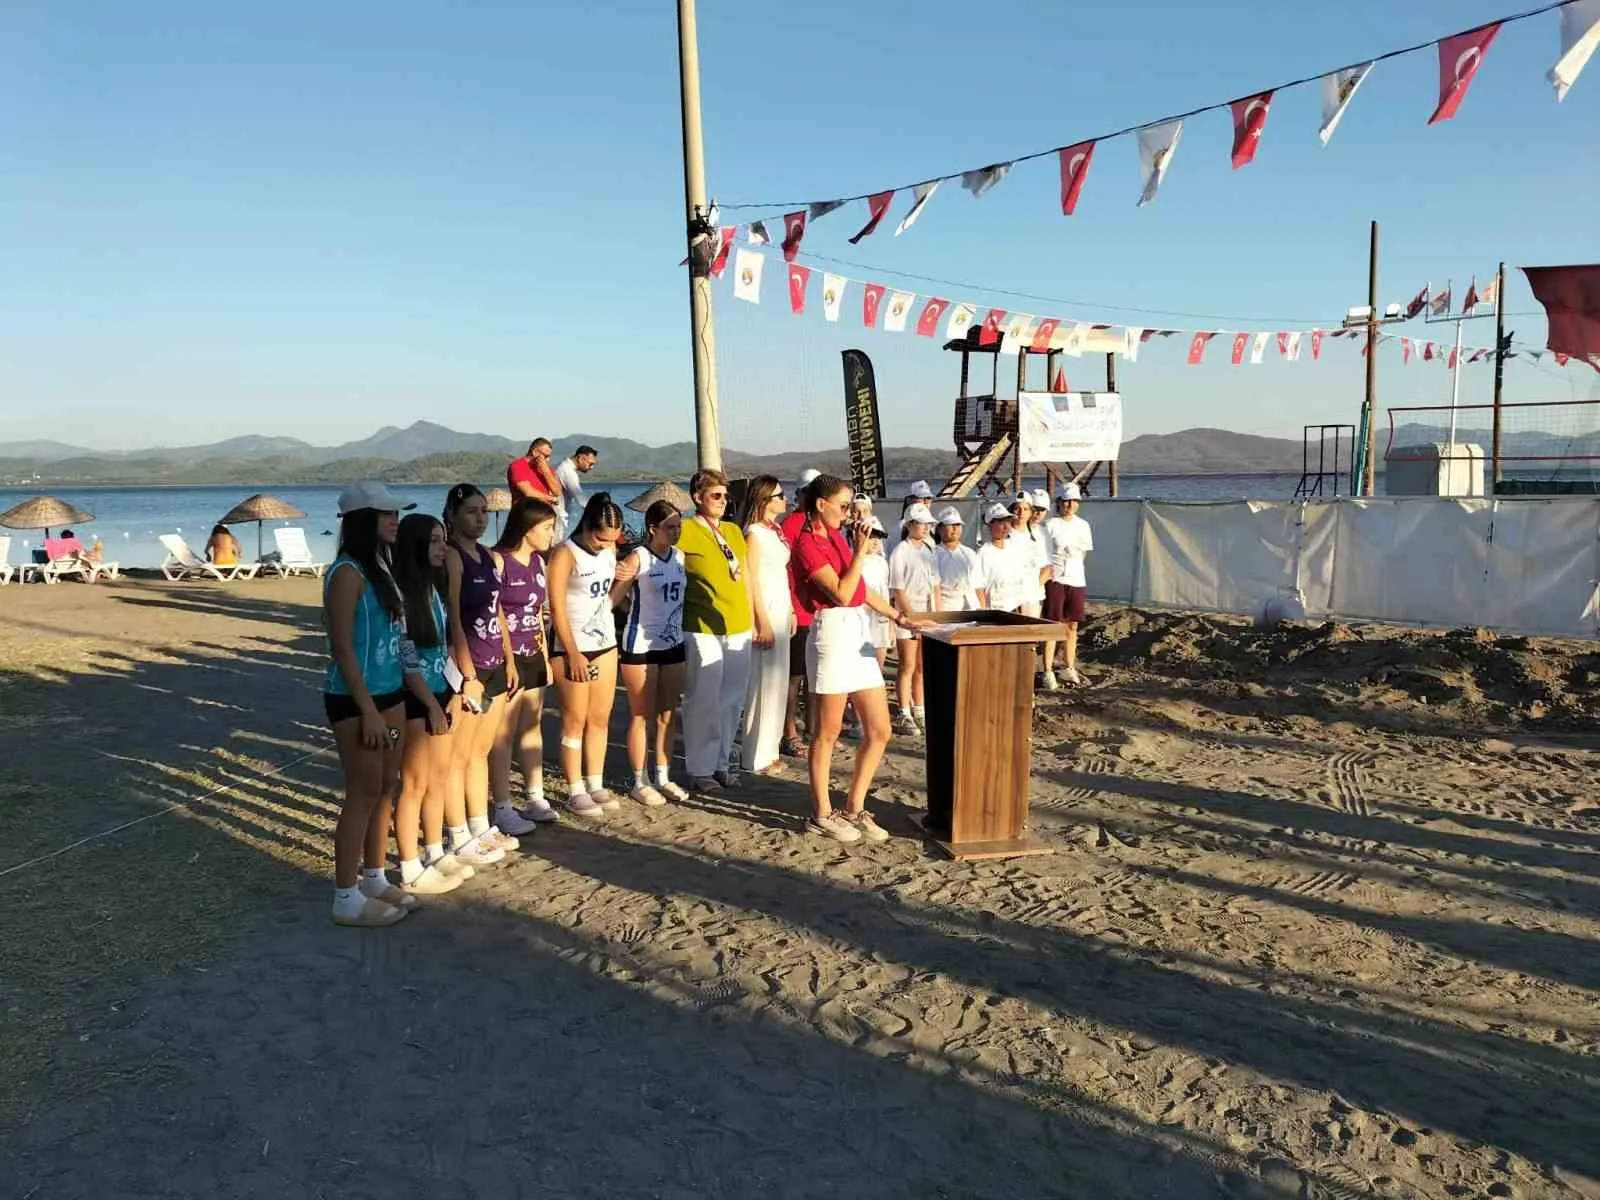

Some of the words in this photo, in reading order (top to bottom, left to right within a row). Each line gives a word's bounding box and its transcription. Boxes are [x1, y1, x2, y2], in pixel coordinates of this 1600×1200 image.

[590, 578, 611, 599] 99
[661, 581, 681, 602] 15
[523, 592, 538, 612] 2
